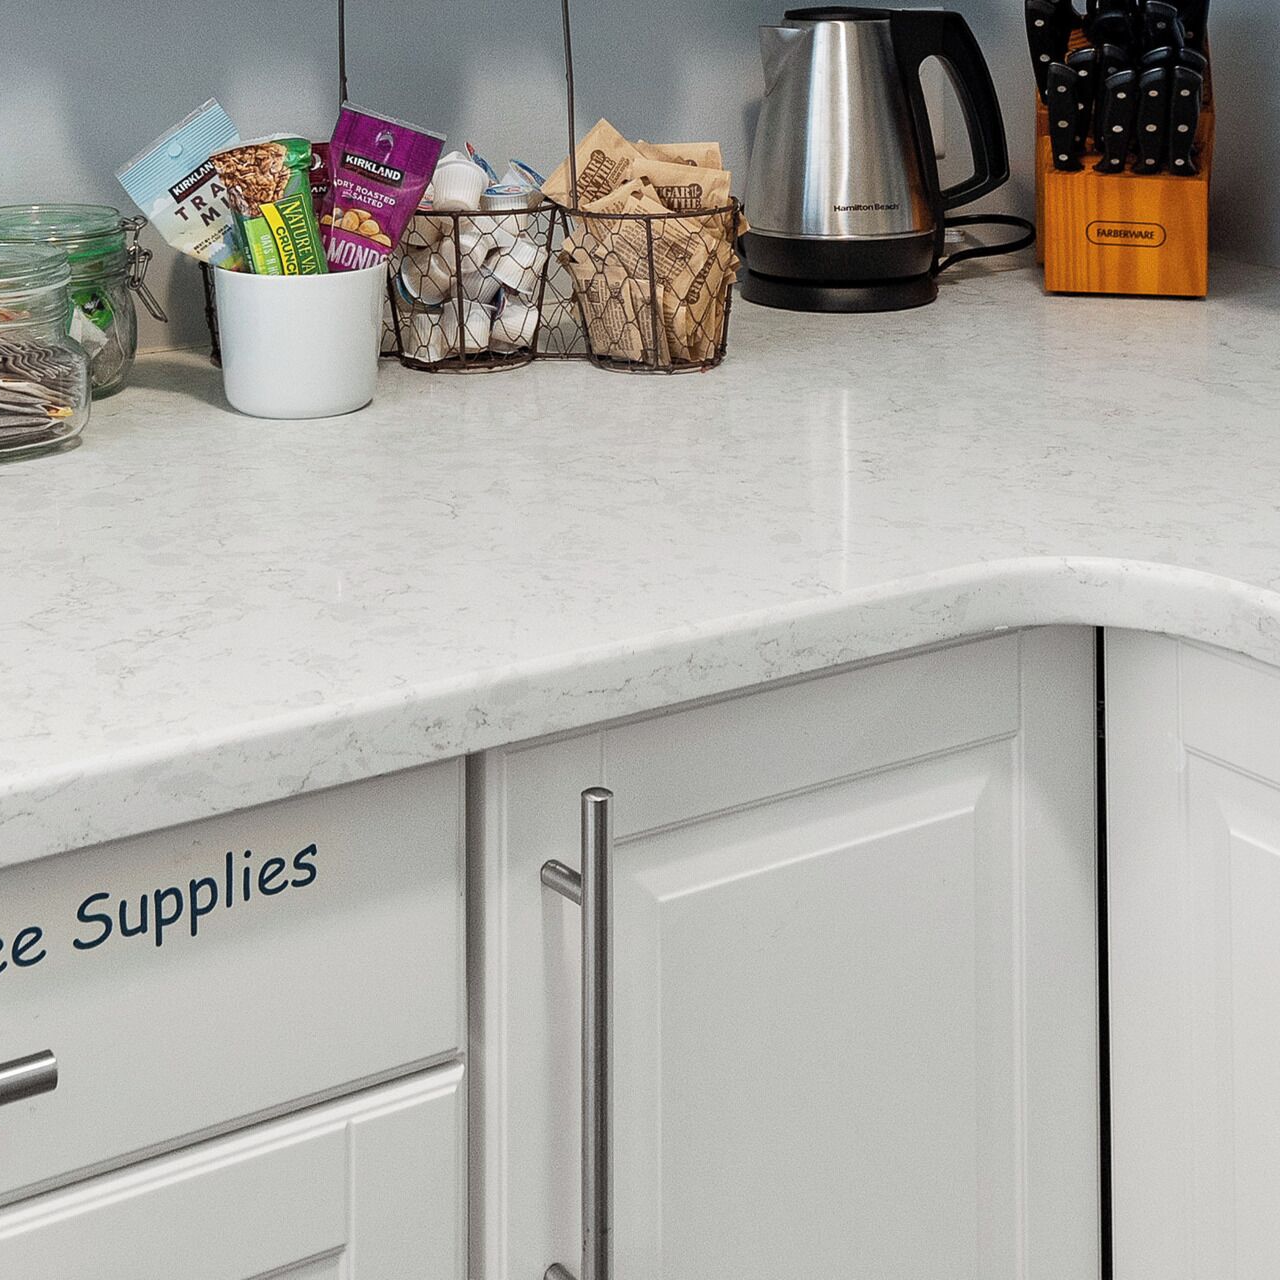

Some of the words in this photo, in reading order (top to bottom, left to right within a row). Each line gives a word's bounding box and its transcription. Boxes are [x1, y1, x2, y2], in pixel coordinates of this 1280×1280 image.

[172, 161, 215, 196] KIRKLAN
[346, 155, 401, 181] KIRKLAND
[337, 178, 354, 190] DRY
[356, 185, 396, 206] ROASTED
[352, 193, 383, 209] SALTED
[834, 204, 873, 212] Hamilton
[279, 200, 312, 257] NATURE
[1097, 228, 1154, 240] FARBERWARE
[276, 226, 298, 275] CRUNC
[72, 843, 318, 950] Supplies
